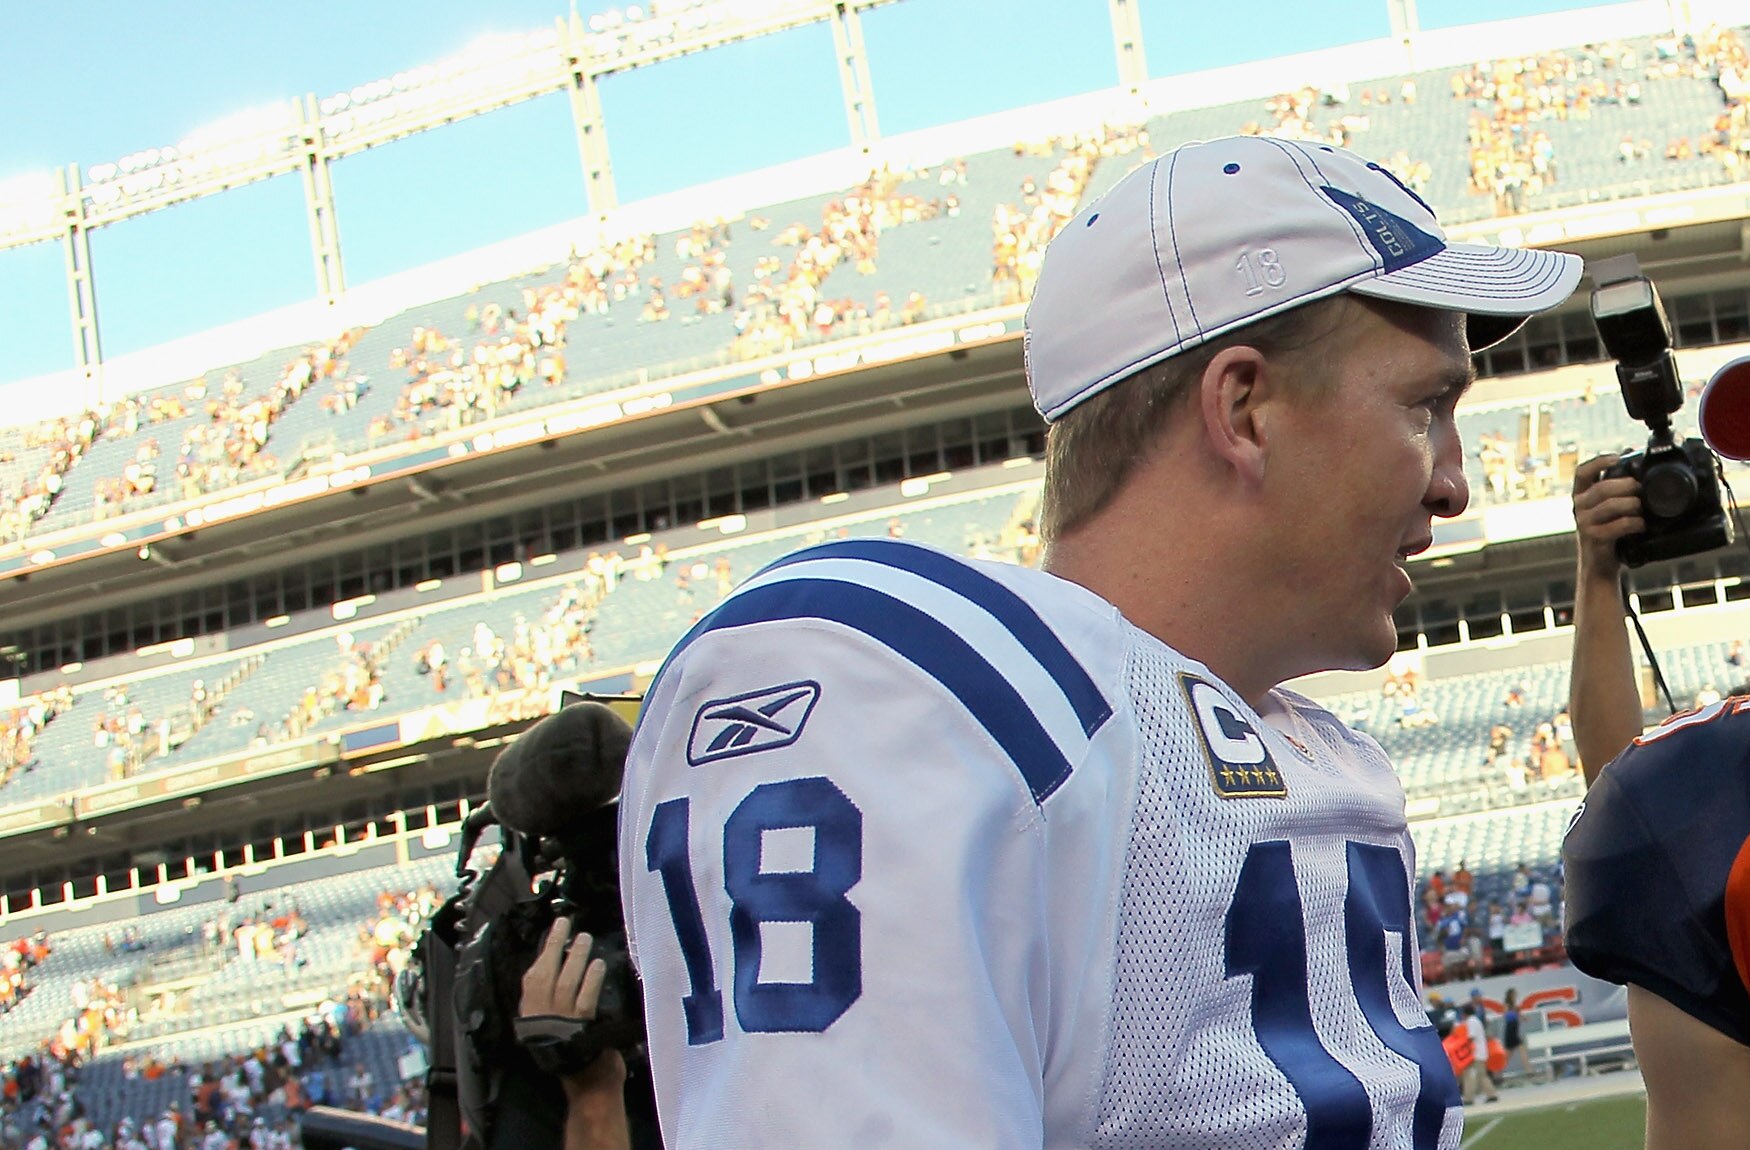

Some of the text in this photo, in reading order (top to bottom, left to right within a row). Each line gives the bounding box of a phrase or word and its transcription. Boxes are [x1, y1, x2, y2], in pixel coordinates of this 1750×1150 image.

[1352, 201, 1404, 257] COLTS
[1235, 248, 1287, 297] 18
[645, 775, 864, 1046] 18
